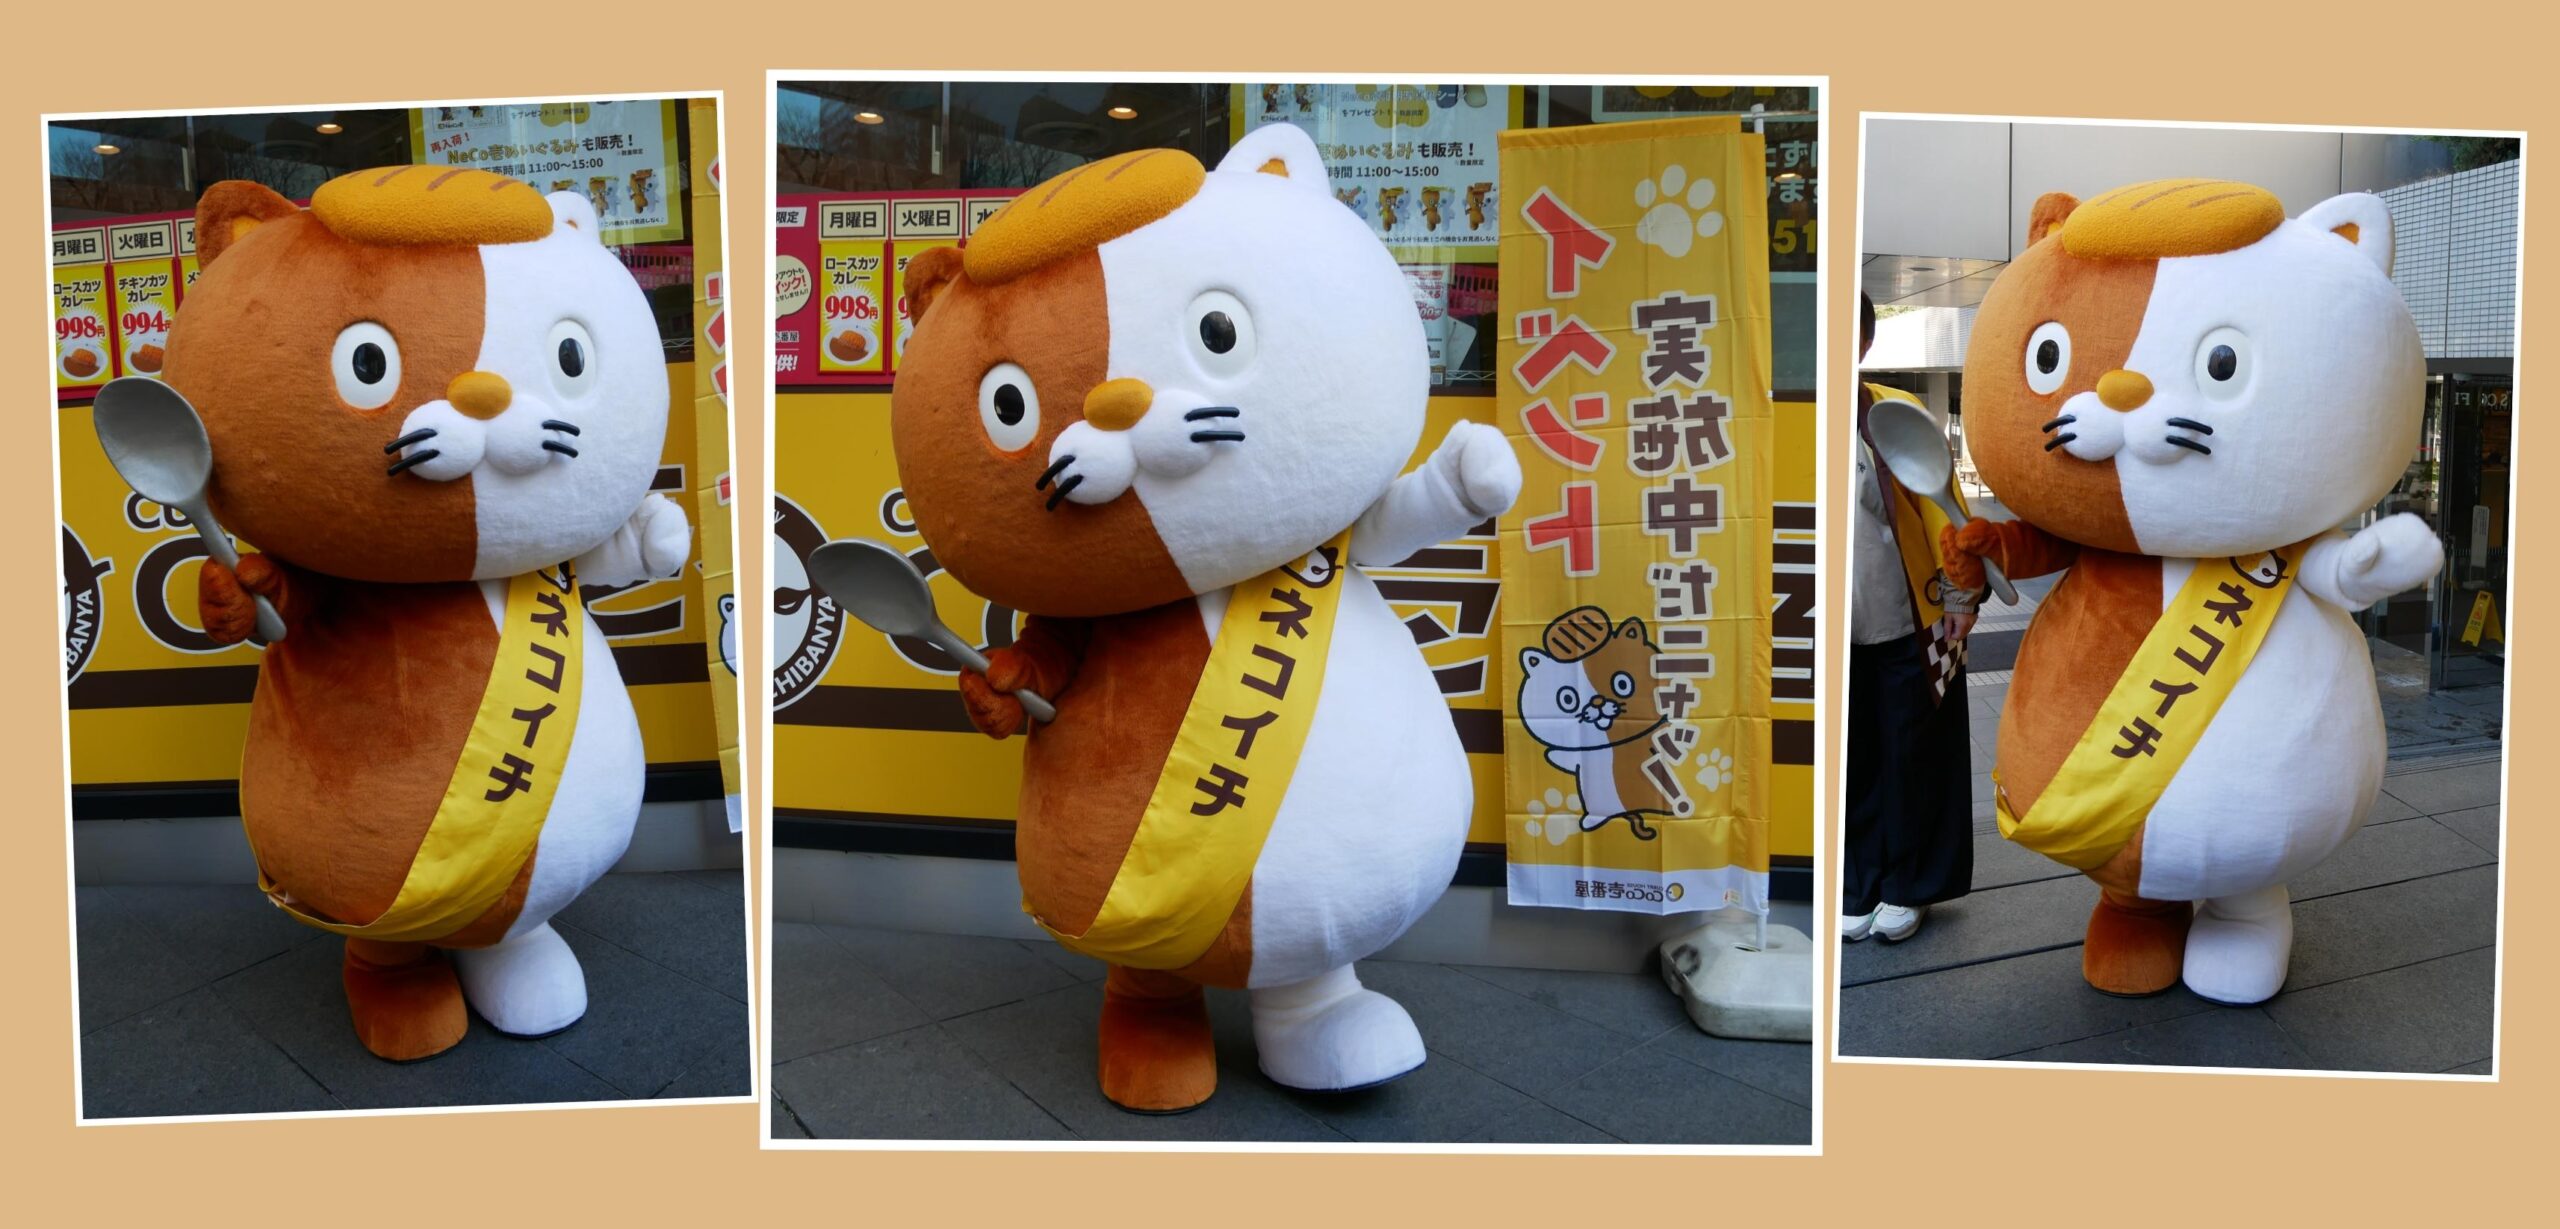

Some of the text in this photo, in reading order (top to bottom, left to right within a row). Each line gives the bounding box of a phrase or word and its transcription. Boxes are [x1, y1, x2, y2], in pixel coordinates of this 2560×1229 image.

[430, 132, 470, 154] 再入荷！
[582, 134, 633, 151] も販売！
[1418, 141, 1474, 158] も販売！
[829, 211, 877, 229] 月曜日
[902, 209, 951, 227] 火曜日
[53, 238, 97, 257] 月曜日
[118, 231, 164, 251] 火曜日
[826, 257, 879, 271] ロースカツ
[118, 274, 169, 290] チキンカツ
[833, 271, 870, 285] カレー
[54, 280, 102, 296] ロースカツ
[127, 289, 162, 303] カレー
[61, 295, 95, 308] カレー
[825, 295, 879, 320] 998円
[56, 315, 106, 340] 998円
[2110, 581, 2254, 759] ネコイチ
[484, 591, 570, 802] ネコイチ
[1190, 587, 1313, 816] ネコイチ
